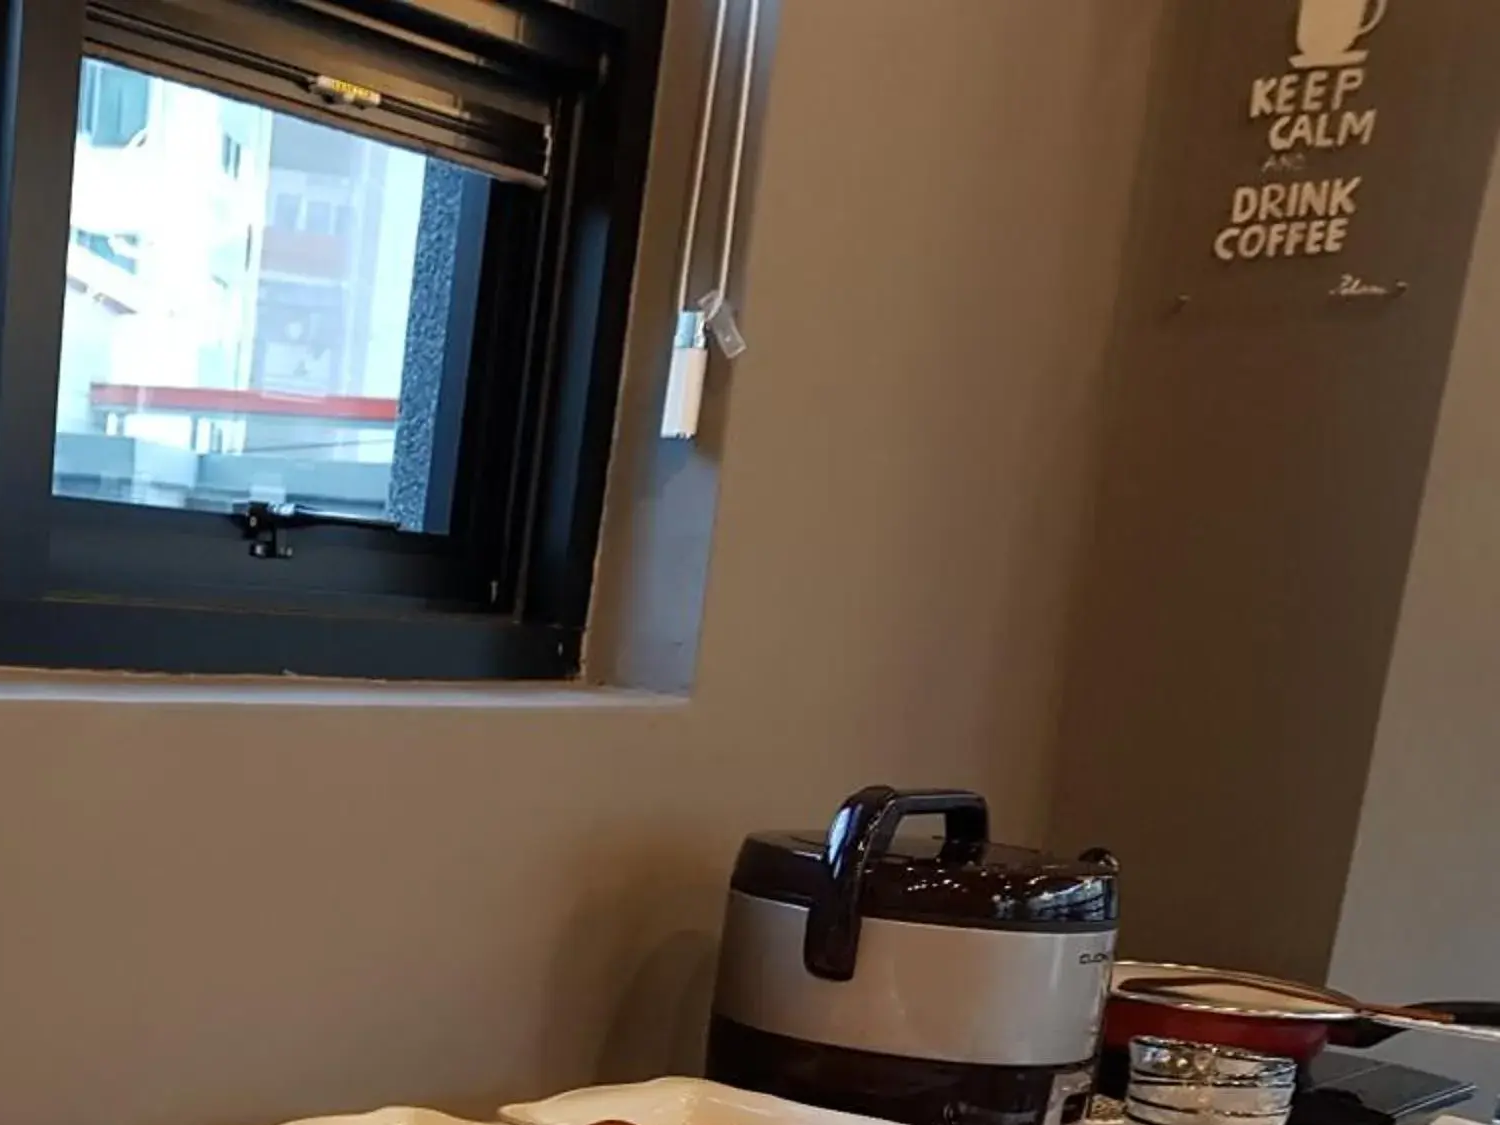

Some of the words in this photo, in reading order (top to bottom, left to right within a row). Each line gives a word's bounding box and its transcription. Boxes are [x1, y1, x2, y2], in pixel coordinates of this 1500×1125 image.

[1250, 69, 1364, 118] KEEP
[1269, 109, 1377, 150] CALM
[1231, 176, 1361, 223] DRINK
[1214, 218, 1349, 260] COFFEE
